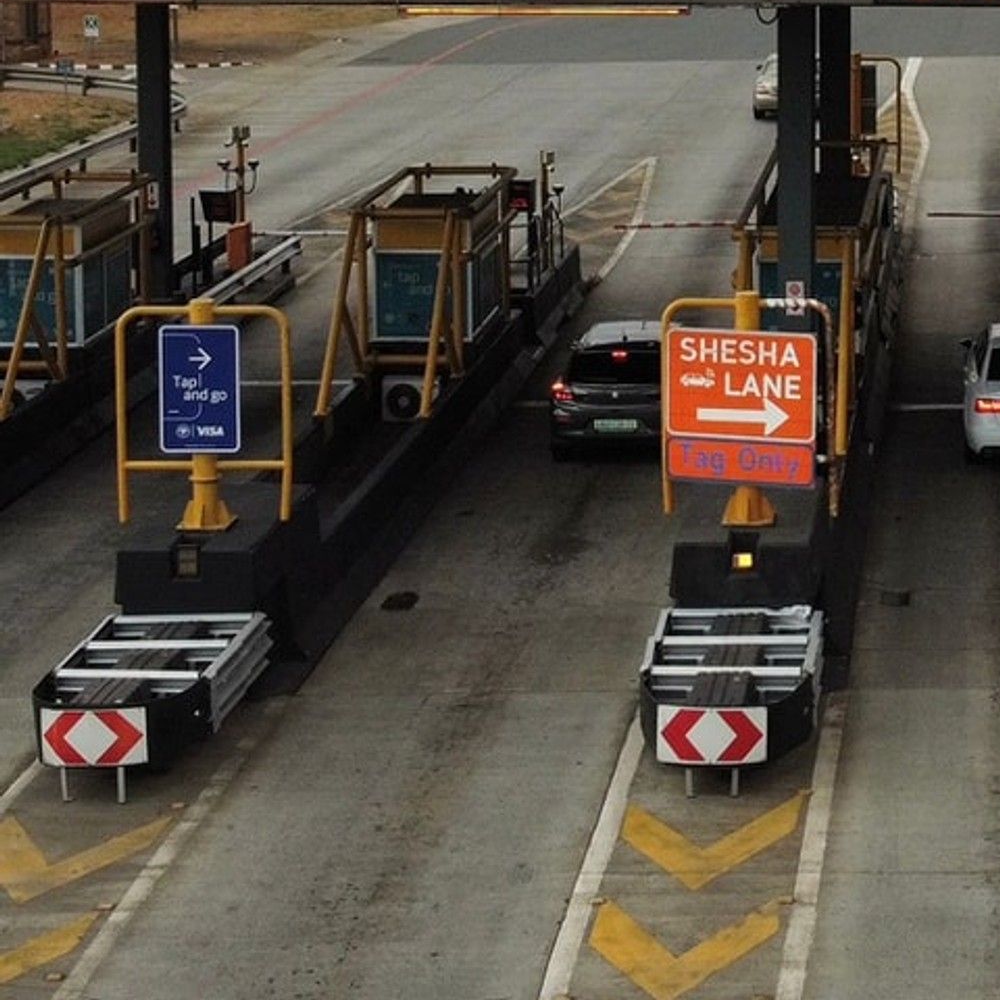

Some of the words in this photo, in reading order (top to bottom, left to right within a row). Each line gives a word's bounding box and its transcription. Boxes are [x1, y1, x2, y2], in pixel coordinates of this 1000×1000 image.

[680, 337, 800, 368] SHESHA
[173, 375, 197, 390] Tap
[724, 370, 802, 399] LANE
[183, 388, 209, 401] and
[210, 389, 228, 404] go
[196, 425, 224, 437] VISA
[680, 442, 726, 475] Tag
[739, 446, 799, 478] Only
